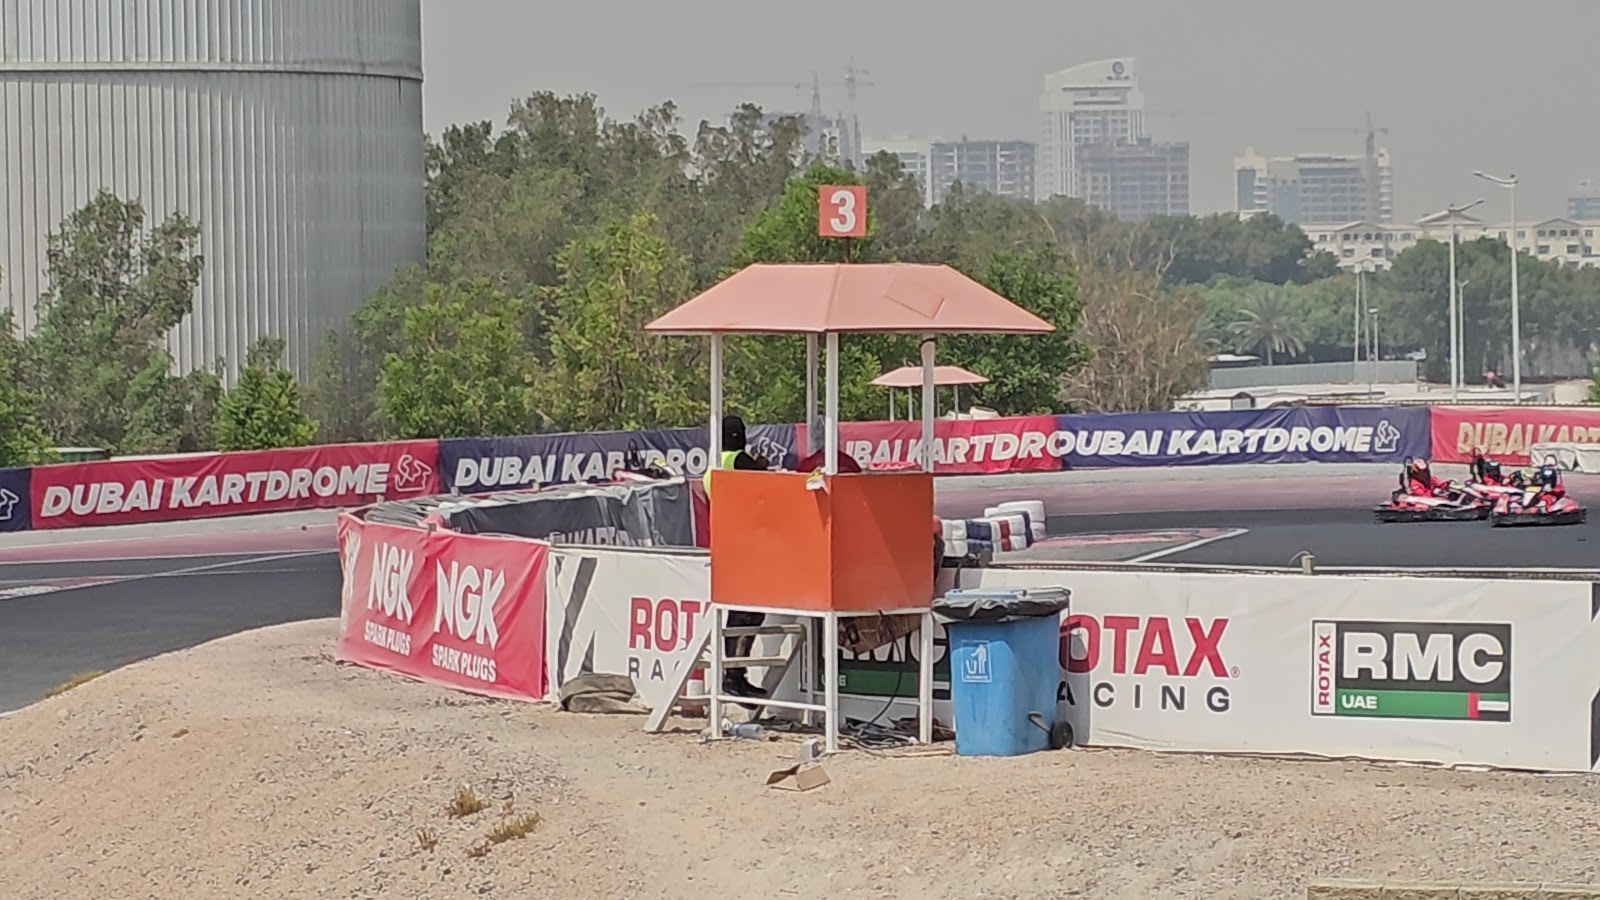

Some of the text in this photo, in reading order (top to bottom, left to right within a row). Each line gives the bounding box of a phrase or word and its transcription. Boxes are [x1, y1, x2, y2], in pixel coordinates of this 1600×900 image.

[830, 190, 856, 233] 3
[1166, 425, 1374, 456] KARTDROME
[1458, 422, 1534, 455] DUBAI
[40, 463, 390, 518] DUBAI KARTDROME
[454, 454, 557, 487] DUBAI
[367, 541, 414, 626] NGK
[433, 558, 506, 650] NGK
[364, 619, 412, 657] SPARK PLUGS
[629, 597, 711, 652] ROT
[1058, 614, 1230, 678] OTAX
[432, 643, 497, 683] SPARK PLUGS
[1318, 633, 1332, 706] ROTAX
[1342, 631, 1504, 684] RMC
[1056, 680, 1230, 713] ACING
[1341, 694, 1378, 710] UAE
